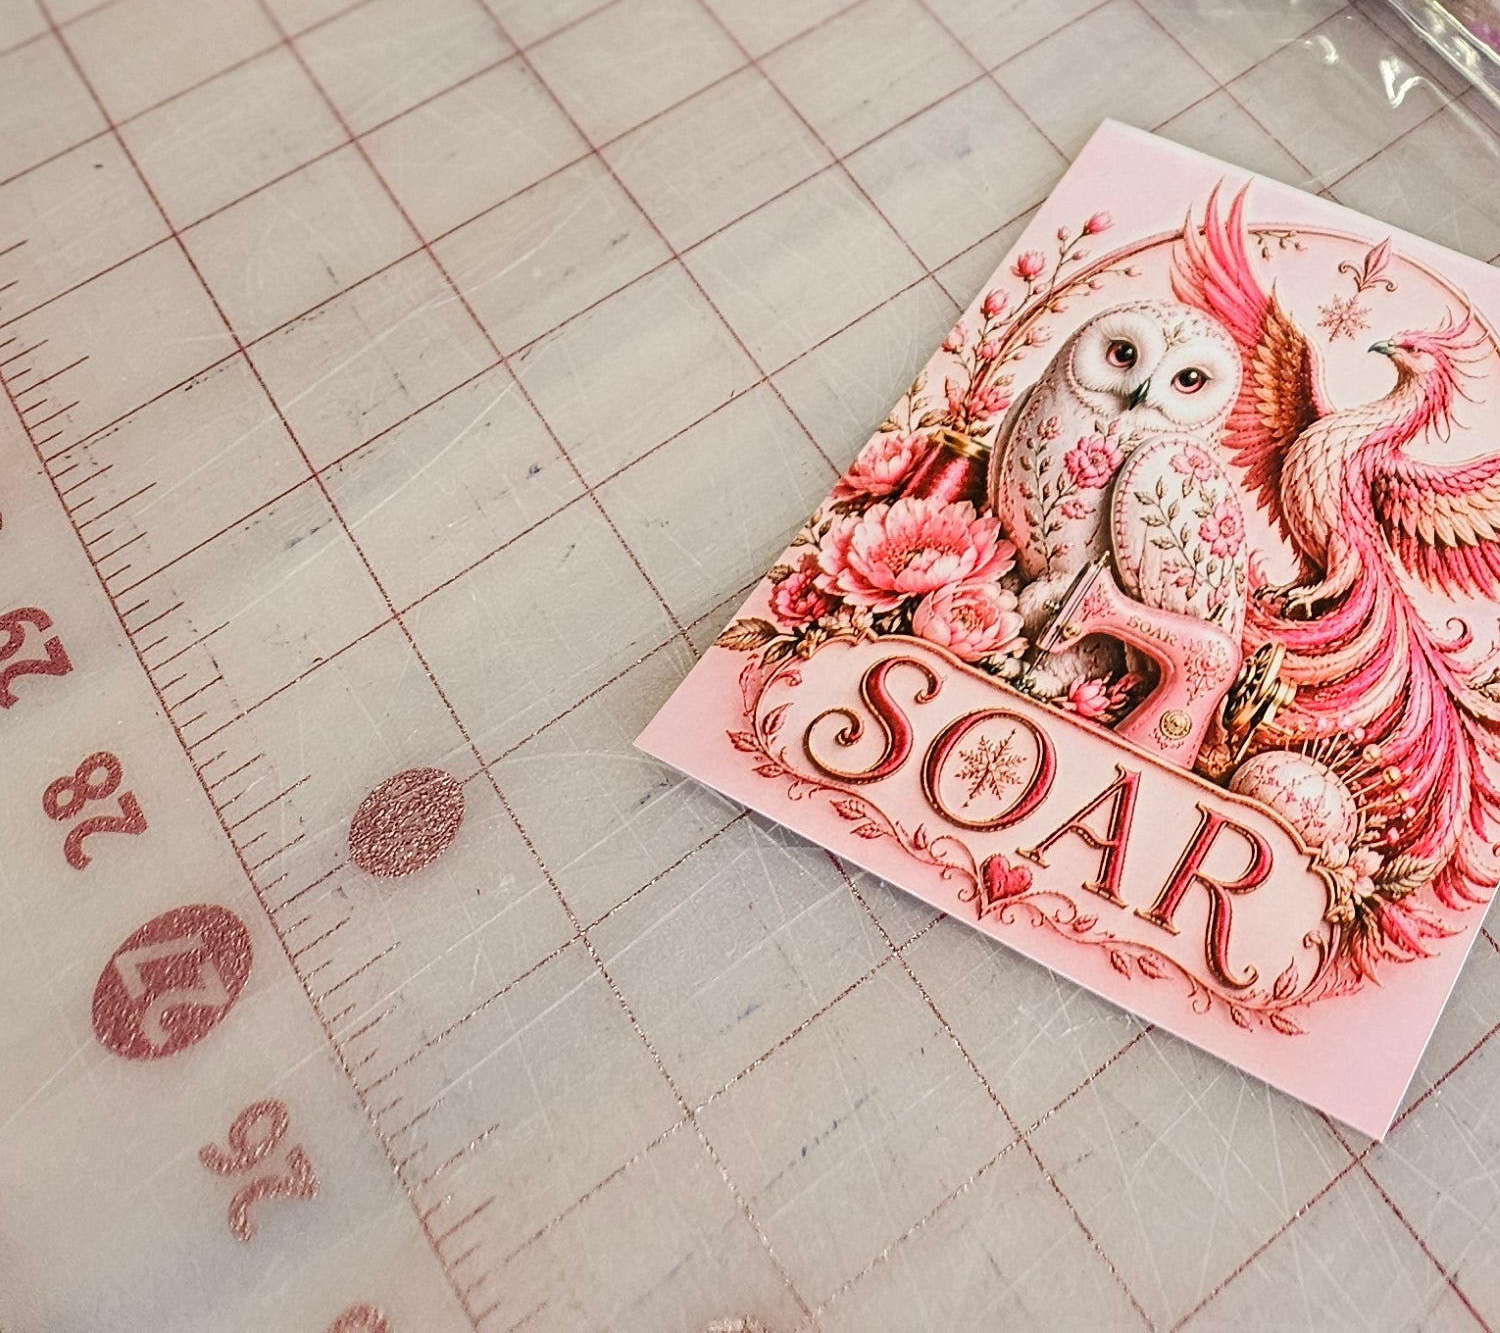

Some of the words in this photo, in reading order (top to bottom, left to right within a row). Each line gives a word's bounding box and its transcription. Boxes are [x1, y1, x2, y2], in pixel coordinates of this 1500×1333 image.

[1126, 615, 1179, 647] SOAR
[43, 750, 149, 871] 28
[803, 655, 1275, 990] SOAR
[113, 933, 229, 1047] 27
[200, 1099, 320, 1243] 26
